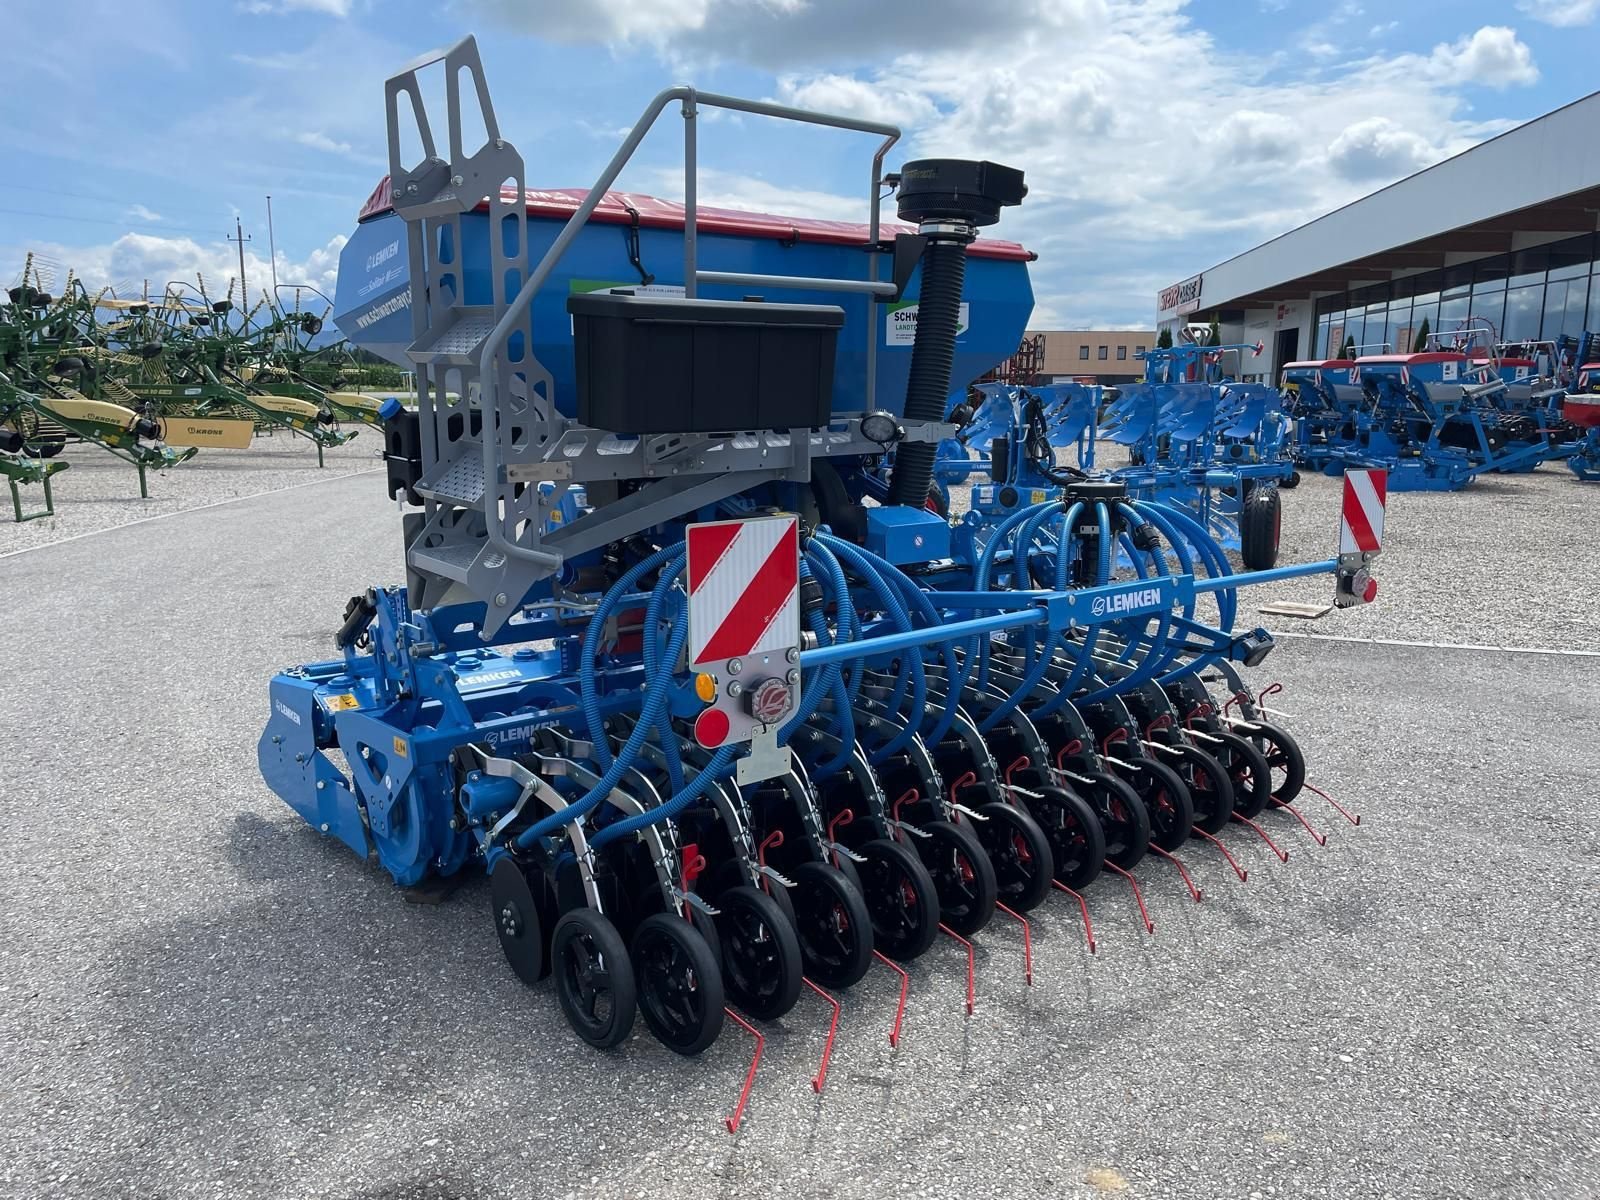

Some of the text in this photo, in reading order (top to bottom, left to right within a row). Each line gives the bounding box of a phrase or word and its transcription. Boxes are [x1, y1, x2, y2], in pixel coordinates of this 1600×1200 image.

[371, 240, 399, 268] LEMKEN
[355, 285, 412, 329] www.schwarzmayr.a
[1106, 587, 1161, 614] LEMKEN
[458, 669, 523, 686] LEMKEN
[280, 702, 301, 727] LEMKEN
